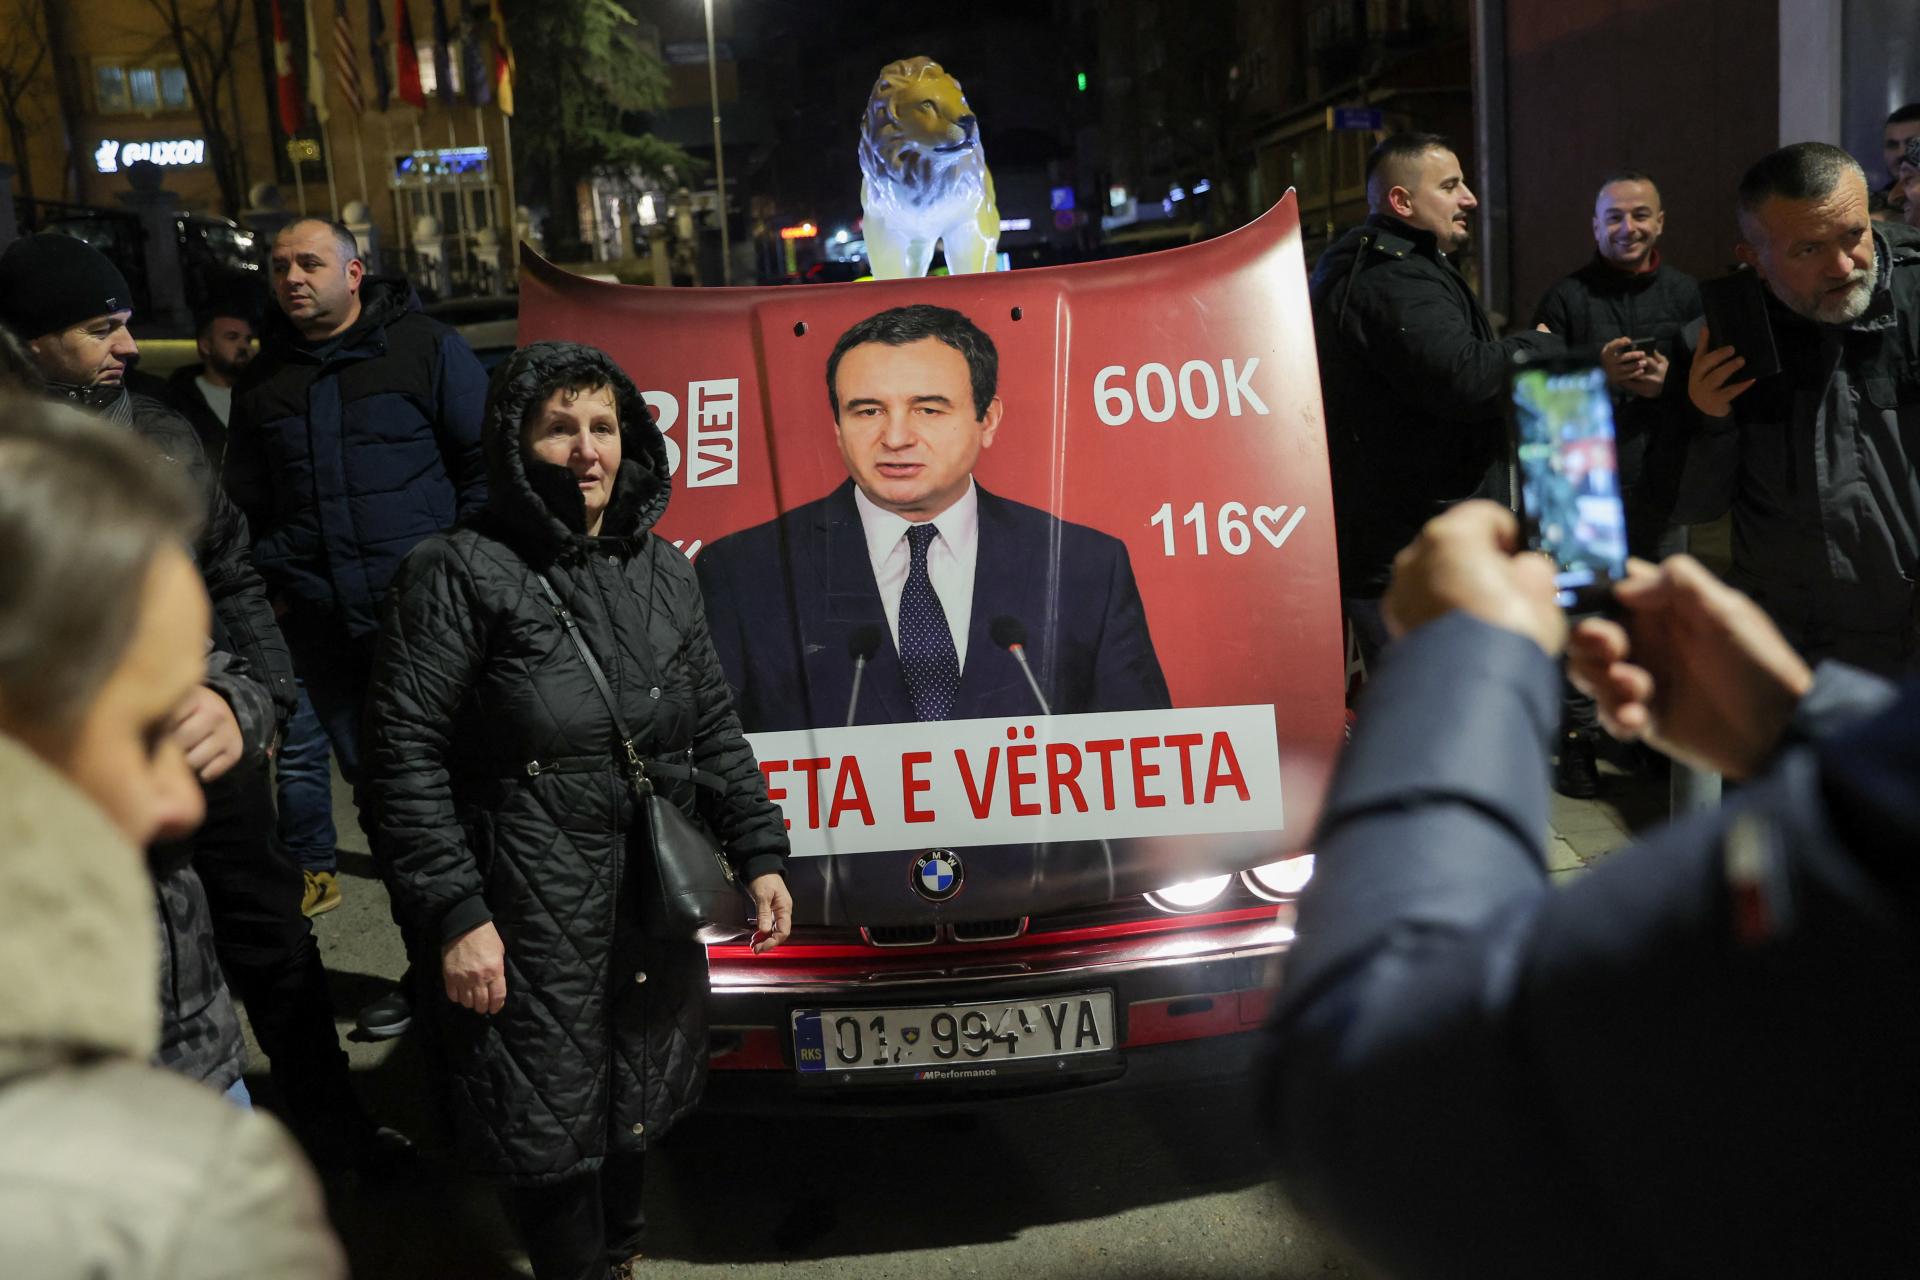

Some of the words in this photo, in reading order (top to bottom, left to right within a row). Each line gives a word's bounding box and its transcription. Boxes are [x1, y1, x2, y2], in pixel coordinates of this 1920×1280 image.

[1093, 357, 1270, 427] 600K
[698, 386, 733, 481] VJET
[1150, 501, 1251, 556] 116
[901, 751, 936, 824] E
[953, 725, 1251, 820] VËRTETA
[917, 851, 957, 868] BMW
[801, 1048, 822, 1061] RKS
